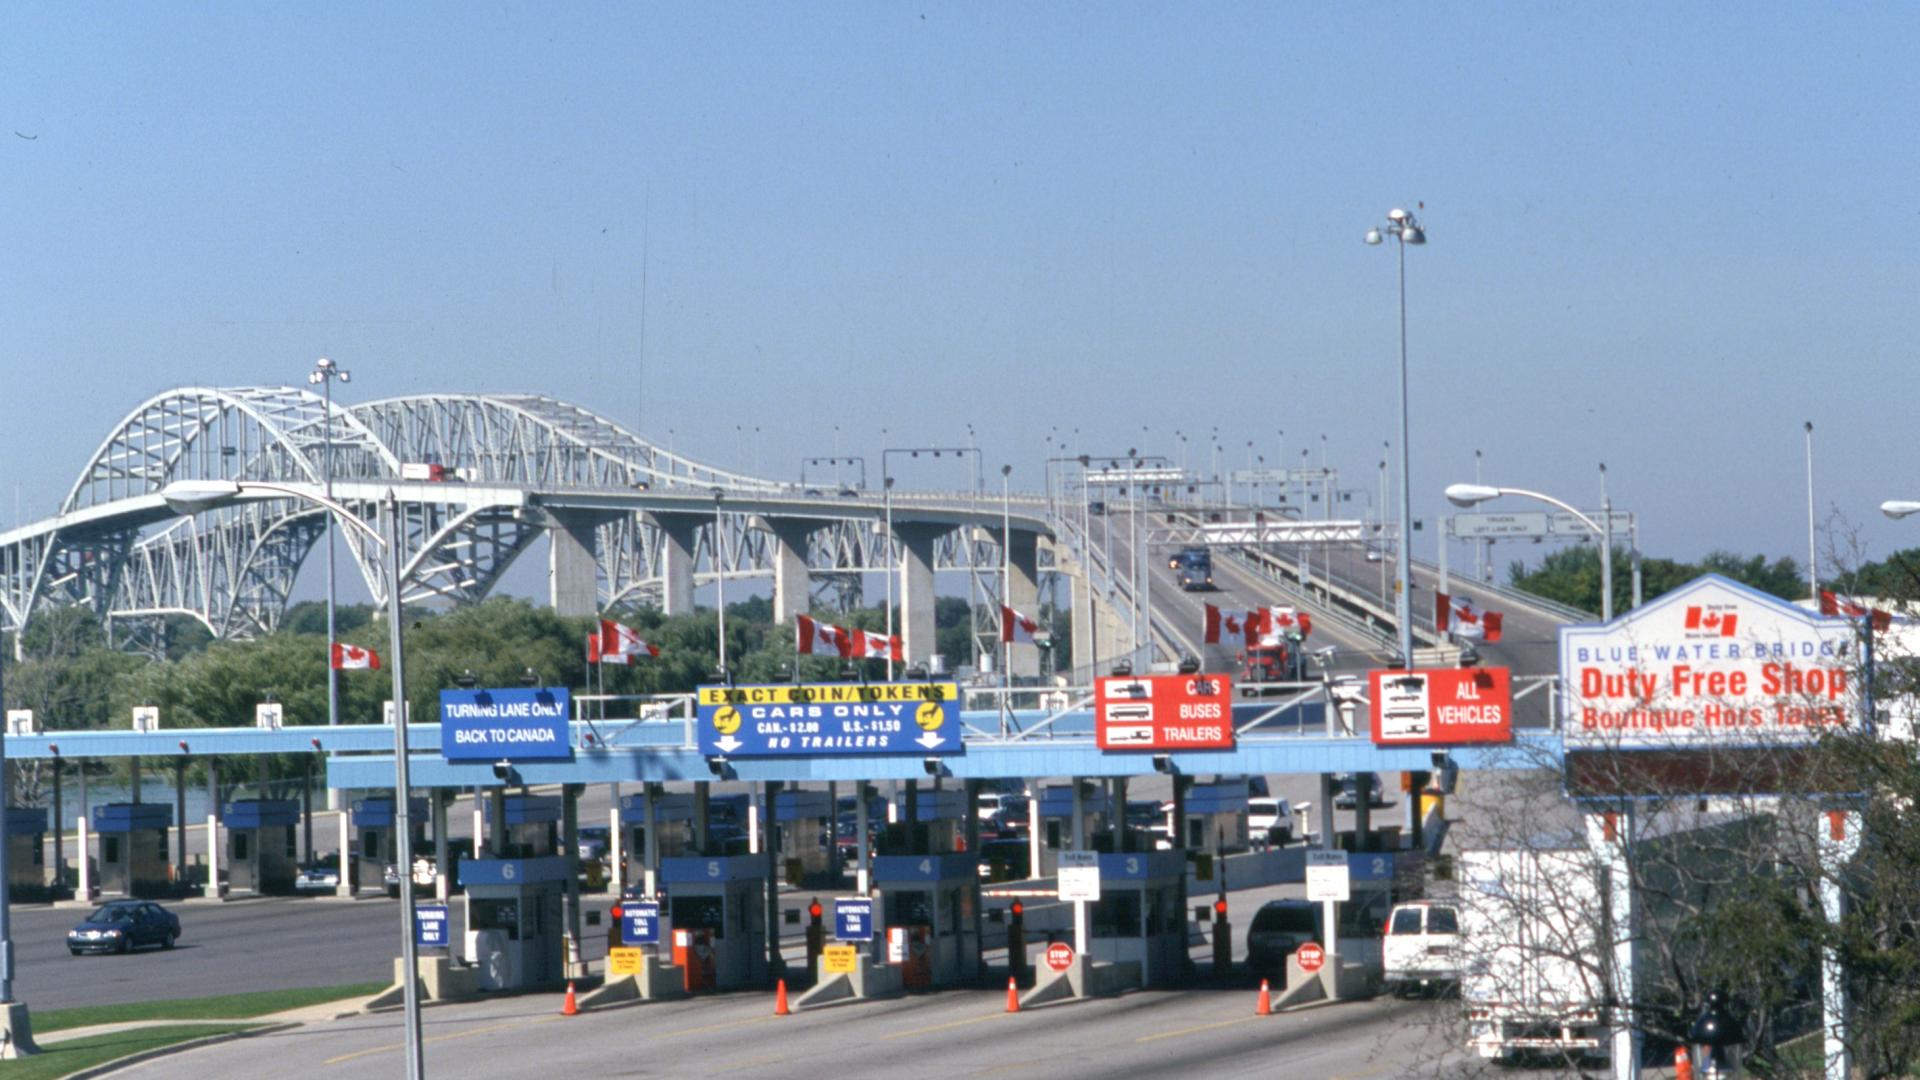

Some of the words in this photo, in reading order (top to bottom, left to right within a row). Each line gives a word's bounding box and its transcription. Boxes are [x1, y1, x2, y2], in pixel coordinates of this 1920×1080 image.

[1577, 647, 1638, 662] BLUE
[1654, 643, 1741, 660] WATER
[1186, 680, 1220, 696] CARS
[1456, 681, 1480, 700] ALL
[1581, 667, 1657, 705] Duty
[1672, 664, 1747, 697] Free
[1761, 661, 1847, 701] Shop
[709, 689, 778, 704] EXACT
[788, 685, 945, 701] COIN/TOKENS
[445, 703, 498, 719] TURNING
[500, 702, 530, 717] LANE
[531, 702, 564, 717] ONLY
[752, 706, 822, 719] CARS
[833, 704, 903, 717] ONLY
[1180, 704, 1221, 720] BUSES
[1437, 704, 1501, 724] VEHICLES
[1582, 706, 1695, 733] Boutique
[1704, 703, 1763, 728] Hors
[455, 729, 488, 743] BACK
[489, 729, 506, 743] TO
[506, 728, 556, 742] CANADA
[1163, 726, 1222, 742] TRAILERS
[768, 737, 791, 749] NO
[801, 735, 889, 749] TRAILERS
[502, 863, 515, 880] 6
[708, 861, 720, 877] 5
[919, 859, 932, 874] 4
[1126, 858, 1139, 875] 3
[1372, 858, 1385, 875] 2
[416, 910, 446, 920] TURNING
[625, 908, 657, 917] AUTOMATIC
[837, 905, 870, 914] AUTOMATIC
[422, 920, 439, 930] LANE
[634, 917, 649, 927] TOLL
[846, 914, 861, 923] TOLL
[633, 927, 649, 936] LANE
[845, 923, 862, 932] LANE
[422, 931, 440, 942] ONLY
[1049, 950, 1070, 959] STOP
[1300, 950, 1321, 959] STOP
